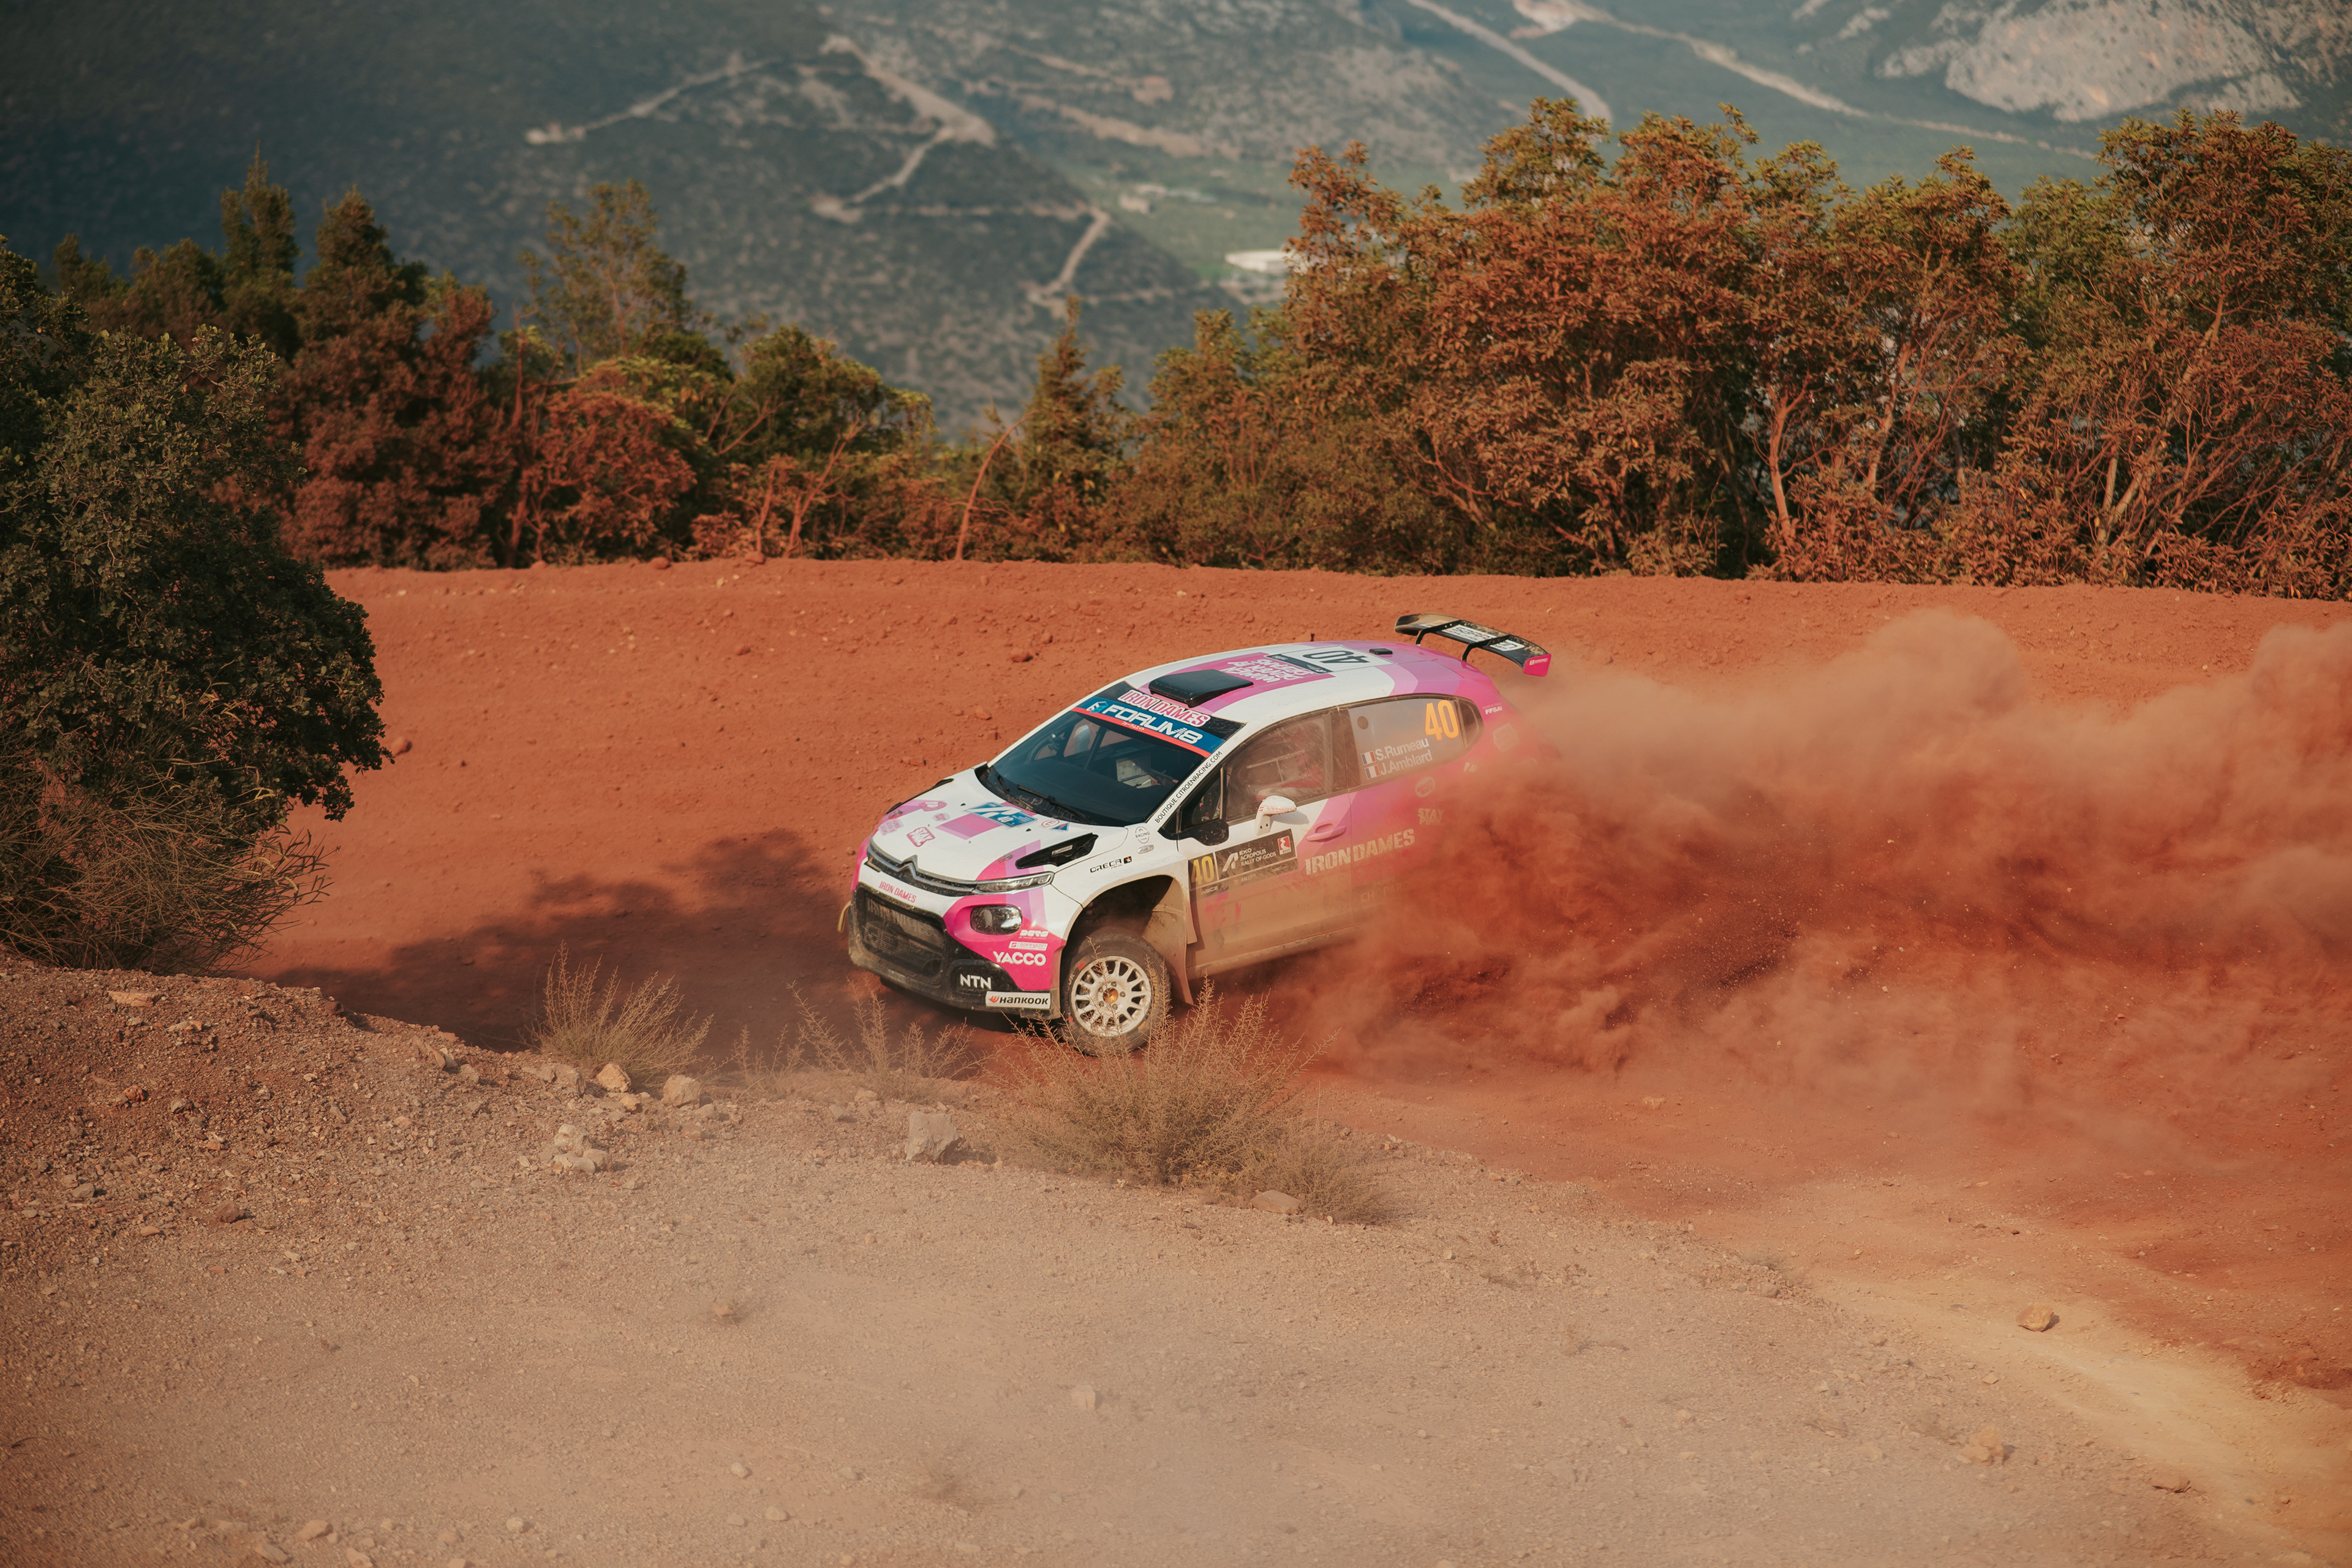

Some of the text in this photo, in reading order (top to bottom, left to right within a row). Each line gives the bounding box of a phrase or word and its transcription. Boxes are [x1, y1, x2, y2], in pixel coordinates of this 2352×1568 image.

[1302, 650, 1370, 663] 40
[1118, 690, 1210, 727] IRON DAMES
[1425, 699, 1459, 741] 40
[1102, 704, 1203, 744] FORUM8
[1375, 737, 1429, 761] S.Rumeau
[1381, 750, 1433, 775] J.Amblard
[1155, 751, 1223, 823] BOUTIQUE.CITROENRACING.COM
[1418, 808, 1444, 818] STAY
[1240, 849, 1267, 861] ACROPOLIS
[1241, 858, 1255, 867] RALLY
[1263, 851, 1276, 860] GODS
[1305, 828, 1415, 875] IRON DAMES
[1090, 859, 1122, 873] ORECA
[1191, 856, 1215, 885] 40
[879, 881, 916, 903] IRON DAMES
[993, 951, 1046, 966] YACCO
[960, 974, 991, 990] NTN
